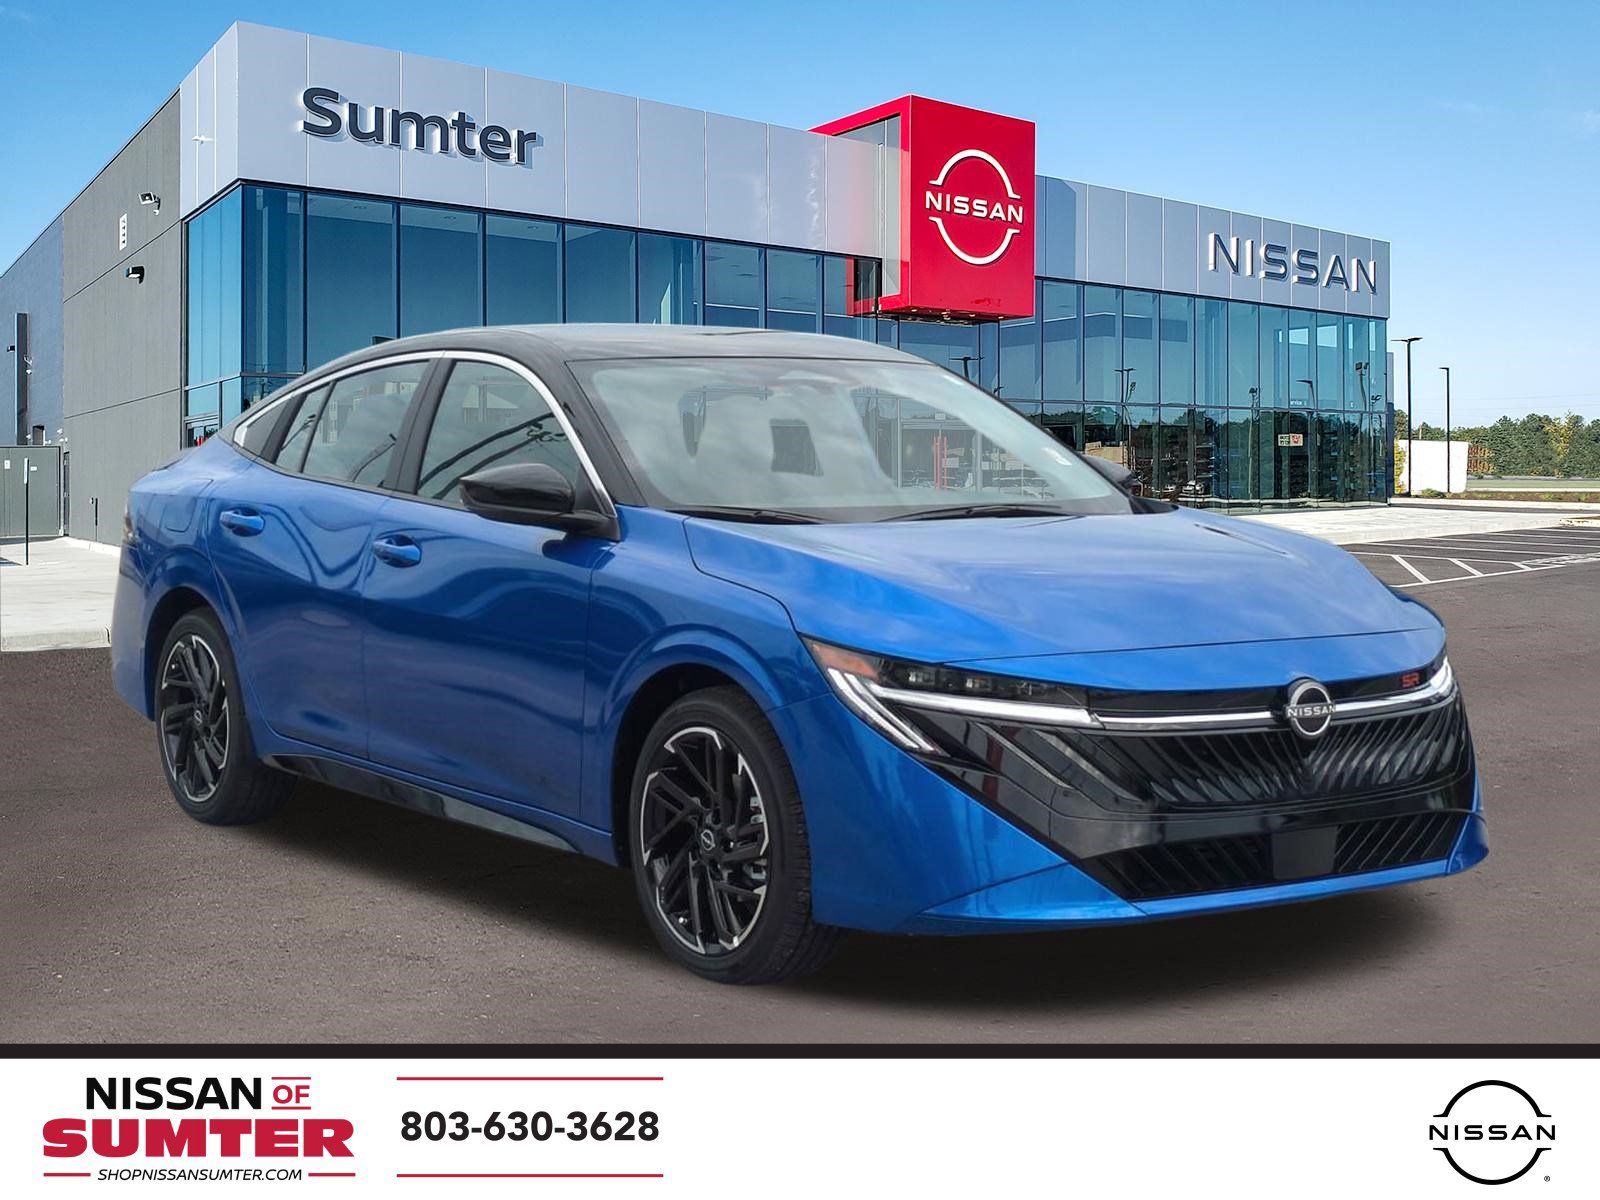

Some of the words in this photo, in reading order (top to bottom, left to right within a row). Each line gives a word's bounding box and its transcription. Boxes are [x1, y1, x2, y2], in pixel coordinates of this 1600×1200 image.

[301, 87, 537, 165] Sumter
[926, 191, 1024, 224] NISSAN
[1208, 232, 1377, 294] NISSAN
[1402, 673, 1420, 687] SR
[1286, 705, 1337, 718] NISSAN
